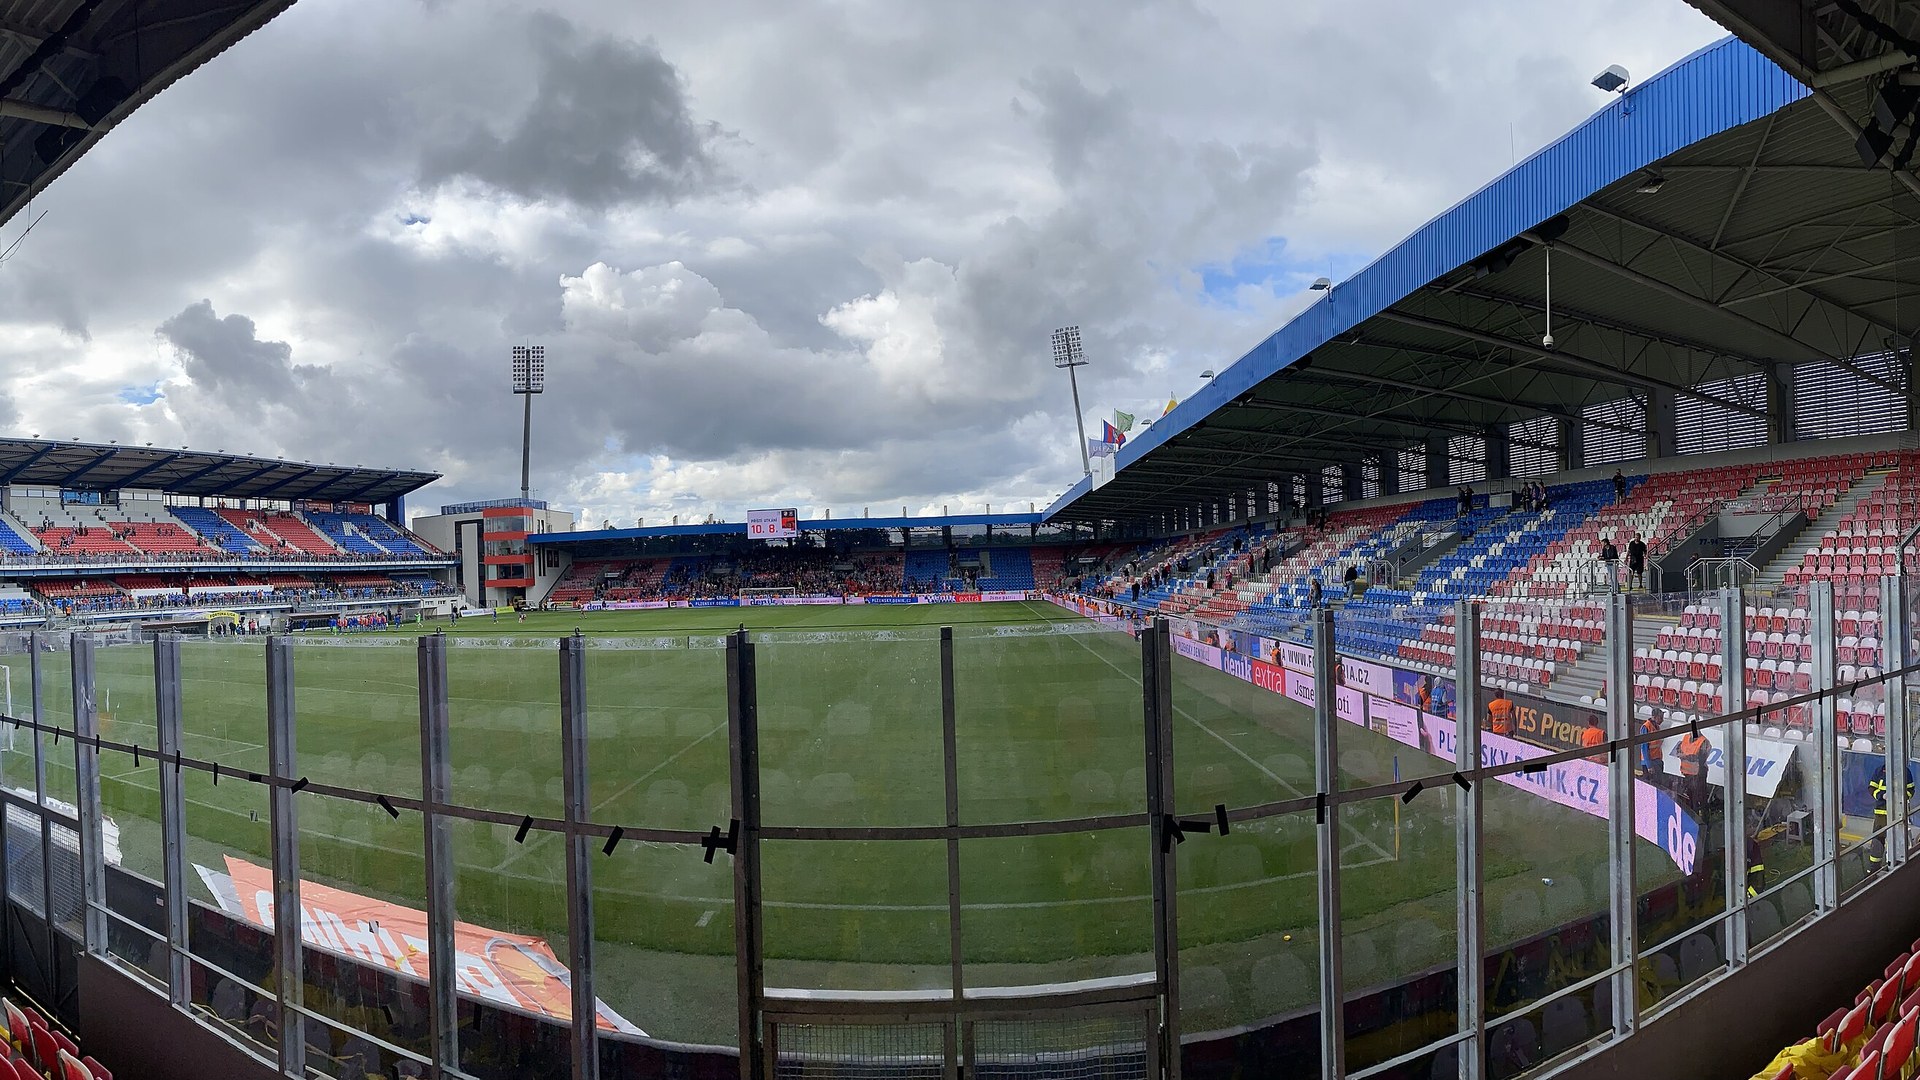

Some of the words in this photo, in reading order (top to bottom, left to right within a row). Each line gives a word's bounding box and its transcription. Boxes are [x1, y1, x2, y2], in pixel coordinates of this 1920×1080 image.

[751, 524, 765, 534] 10.
[768, 524, 778, 533] 8.
[959, 594, 979, 602] extra
[1255, 665, 1282, 694] extra
[1294, 680, 1315, 701] Jsme
